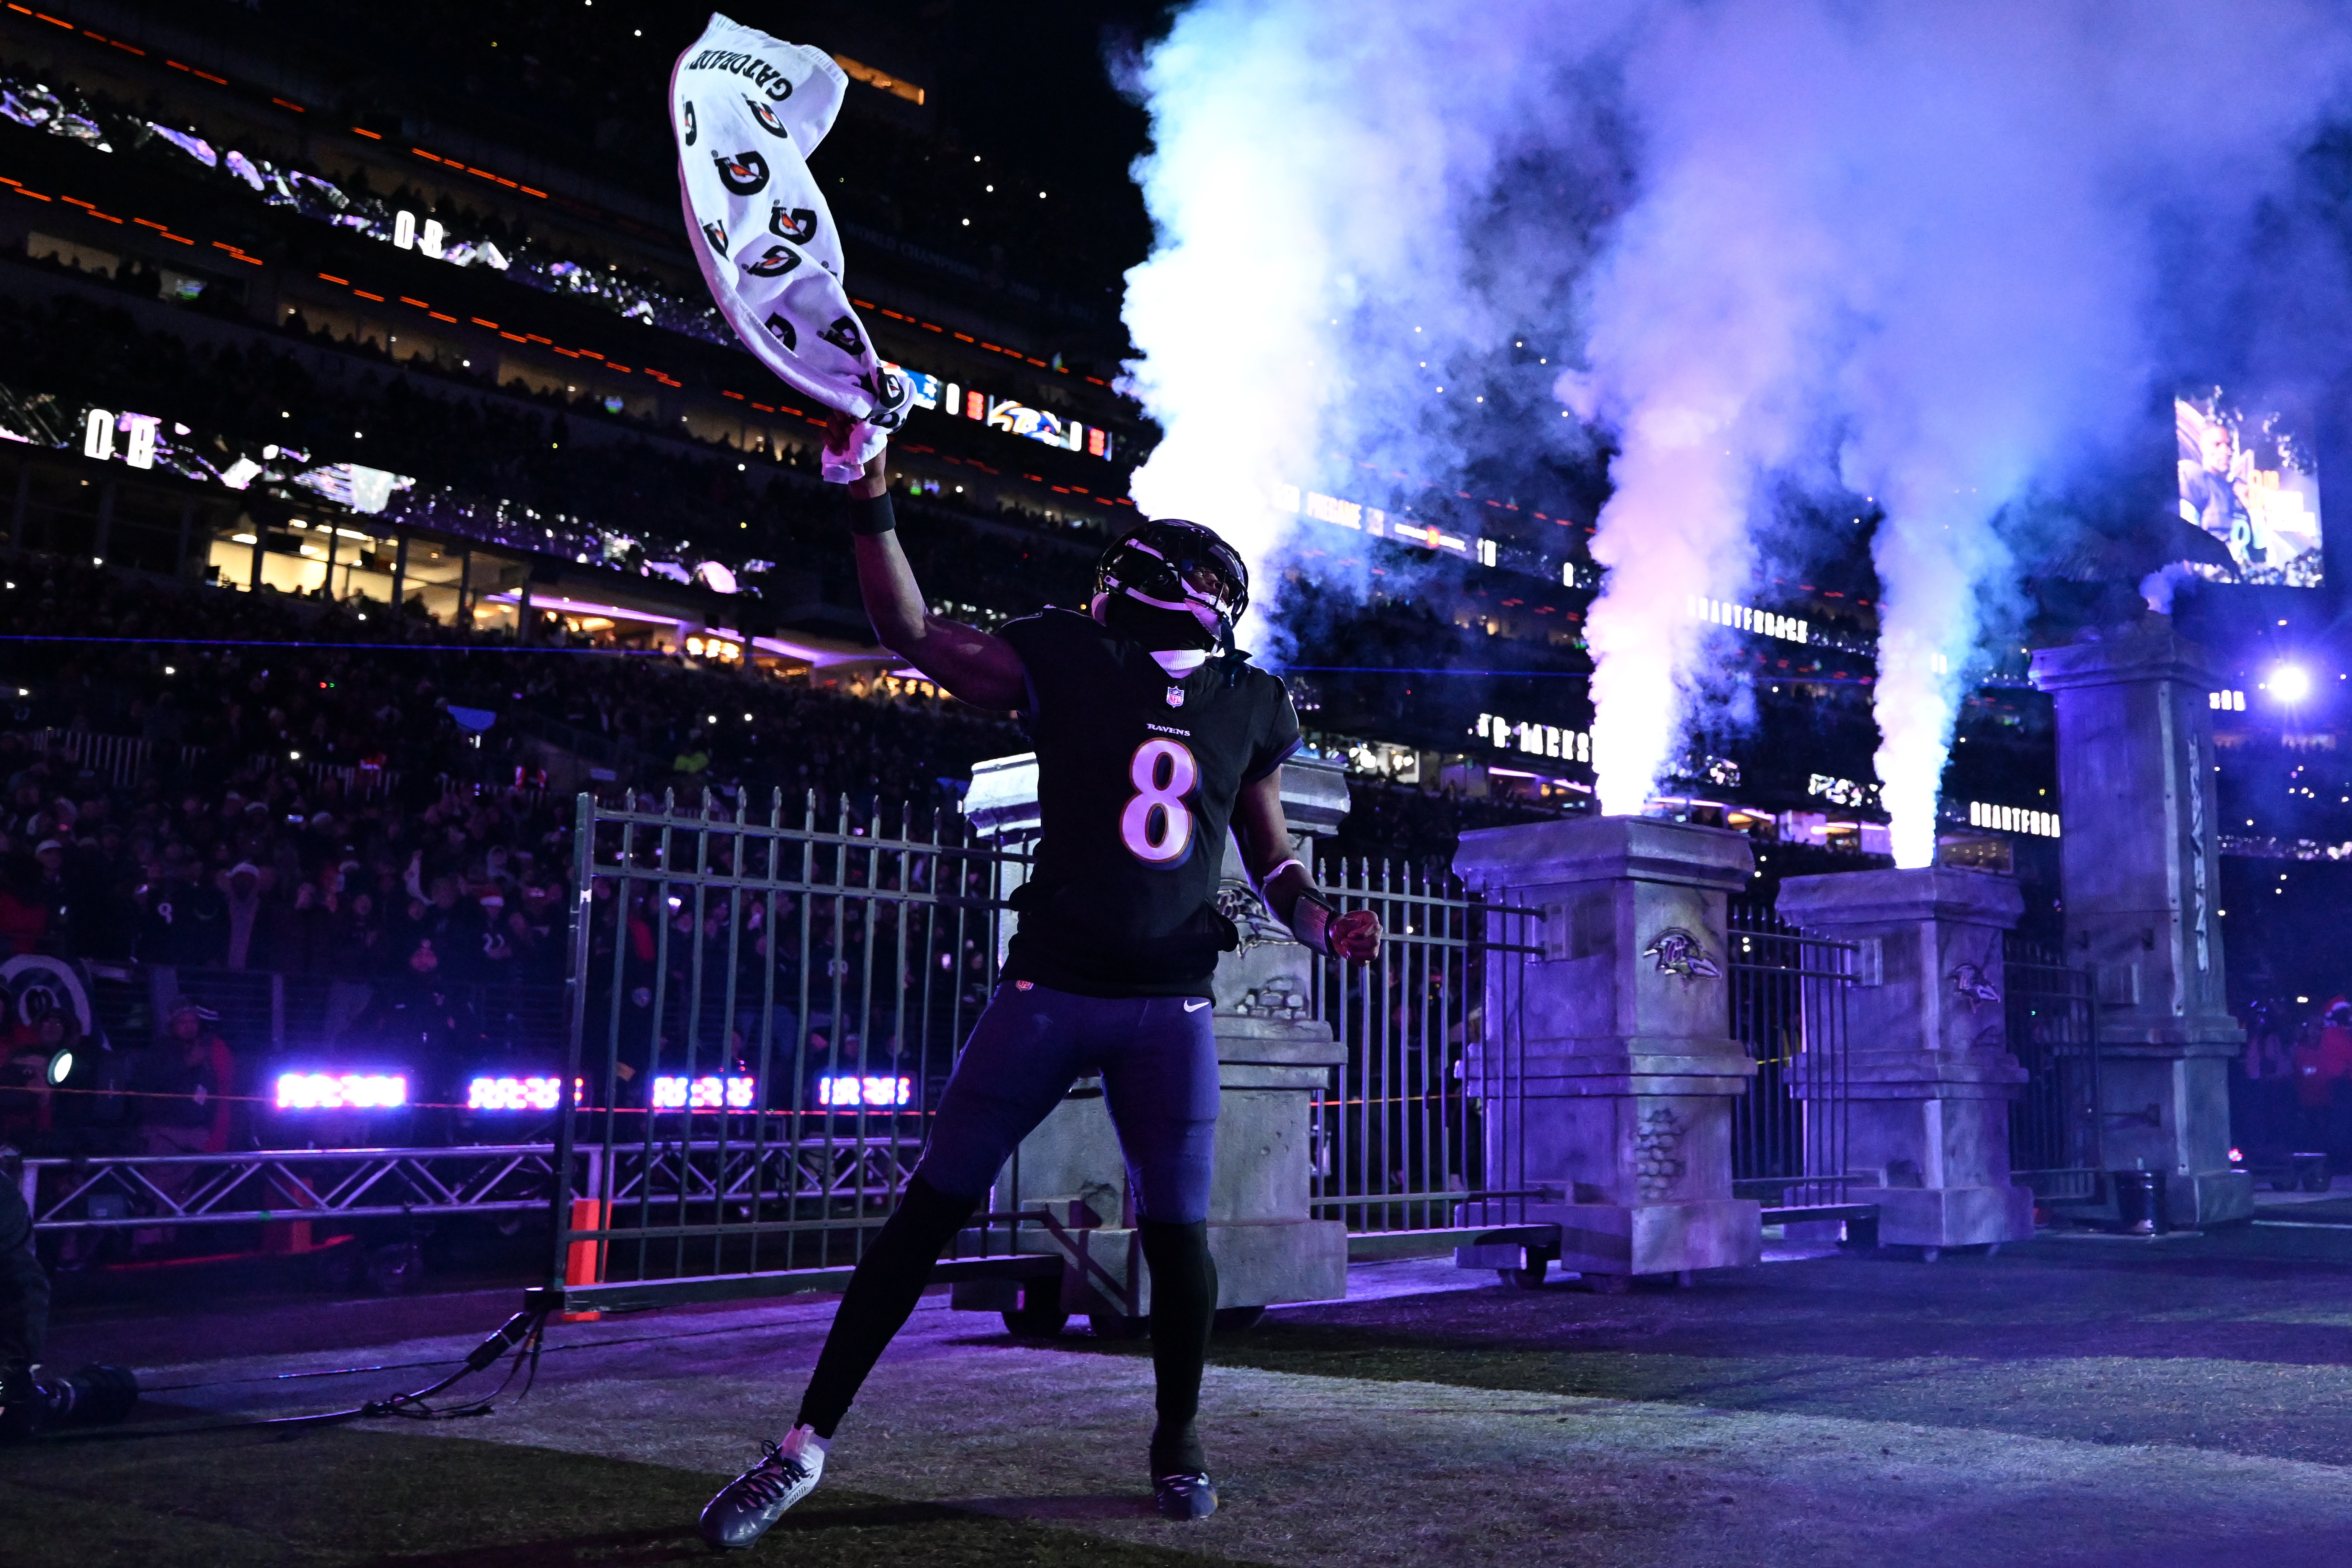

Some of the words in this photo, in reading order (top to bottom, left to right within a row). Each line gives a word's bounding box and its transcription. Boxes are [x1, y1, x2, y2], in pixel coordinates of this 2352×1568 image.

[688, 49, 793, 102] GATORADE
[1169, 694, 1182, 704] NFL
[1146, 723, 1191, 737] RAVENS
[1119, 737, 1199, 864] 8
